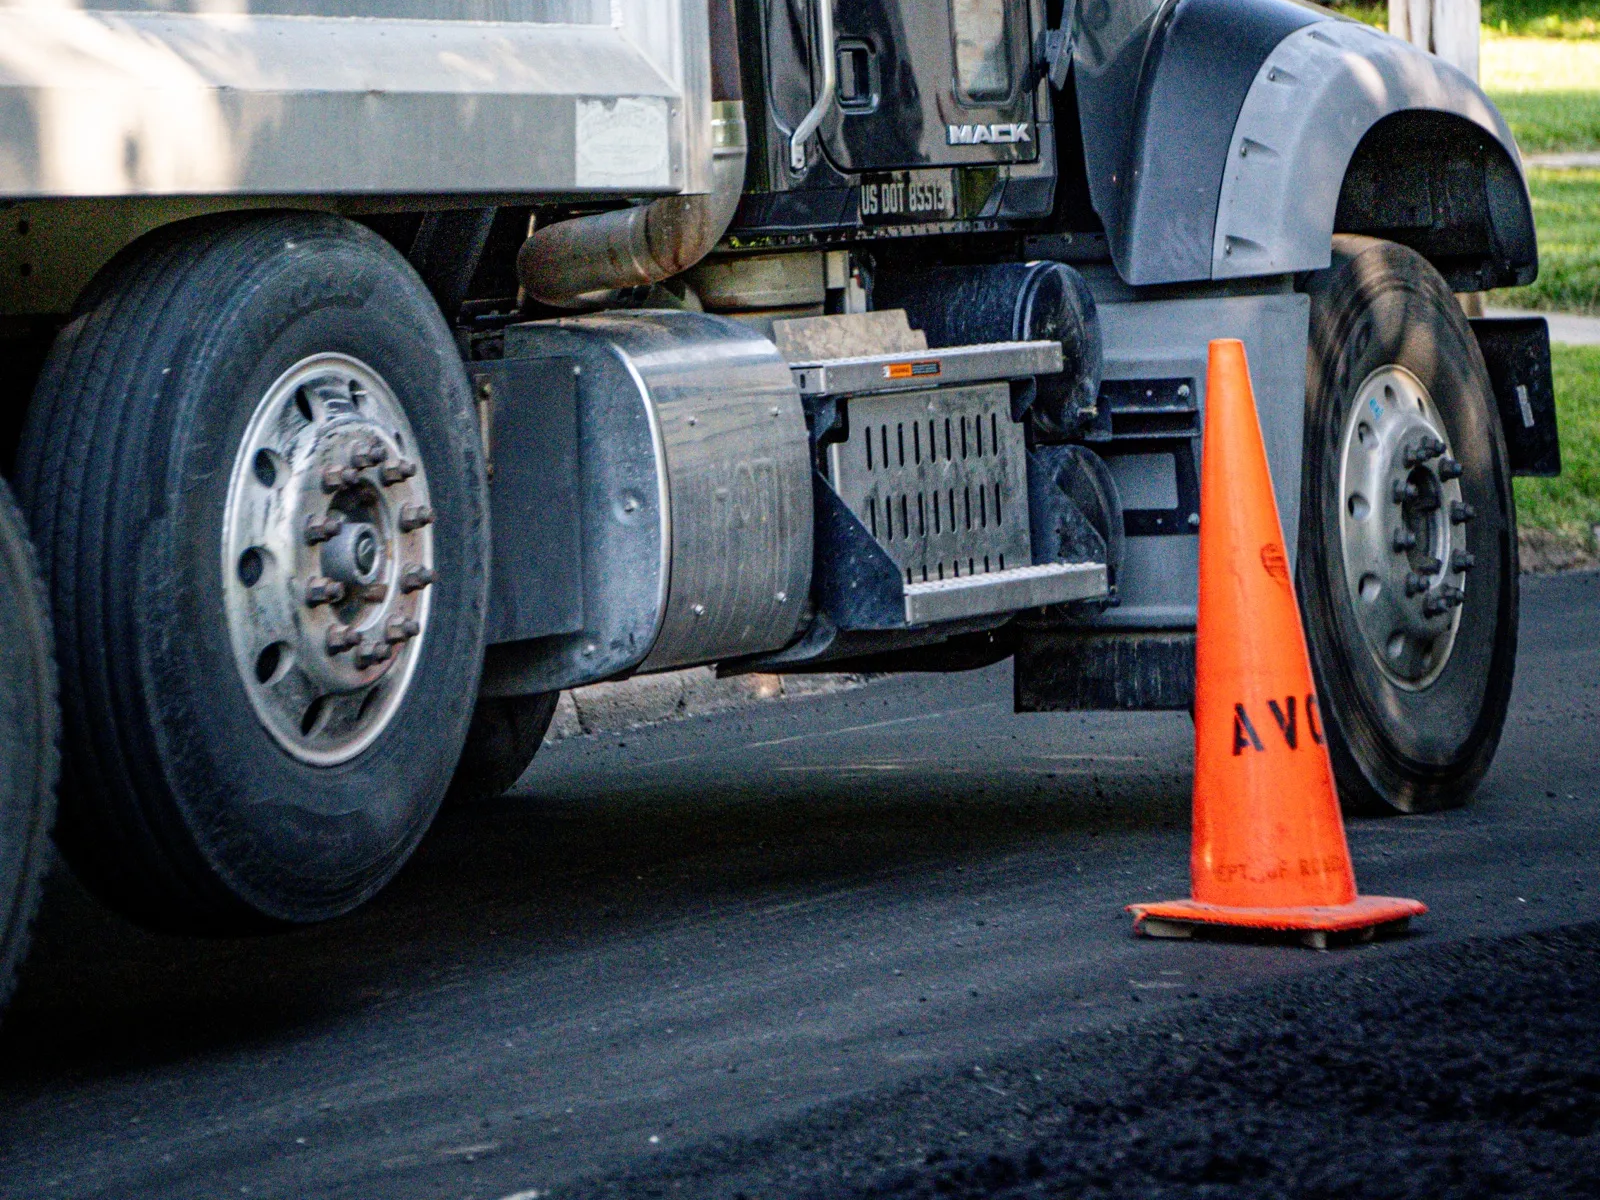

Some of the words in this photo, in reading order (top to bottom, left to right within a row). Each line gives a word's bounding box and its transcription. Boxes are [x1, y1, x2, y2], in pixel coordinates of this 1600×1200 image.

[948, 123, 1031, 145] MACK
[861, 184, 878, 215] US
[881, 182, 905, 214] DOT
